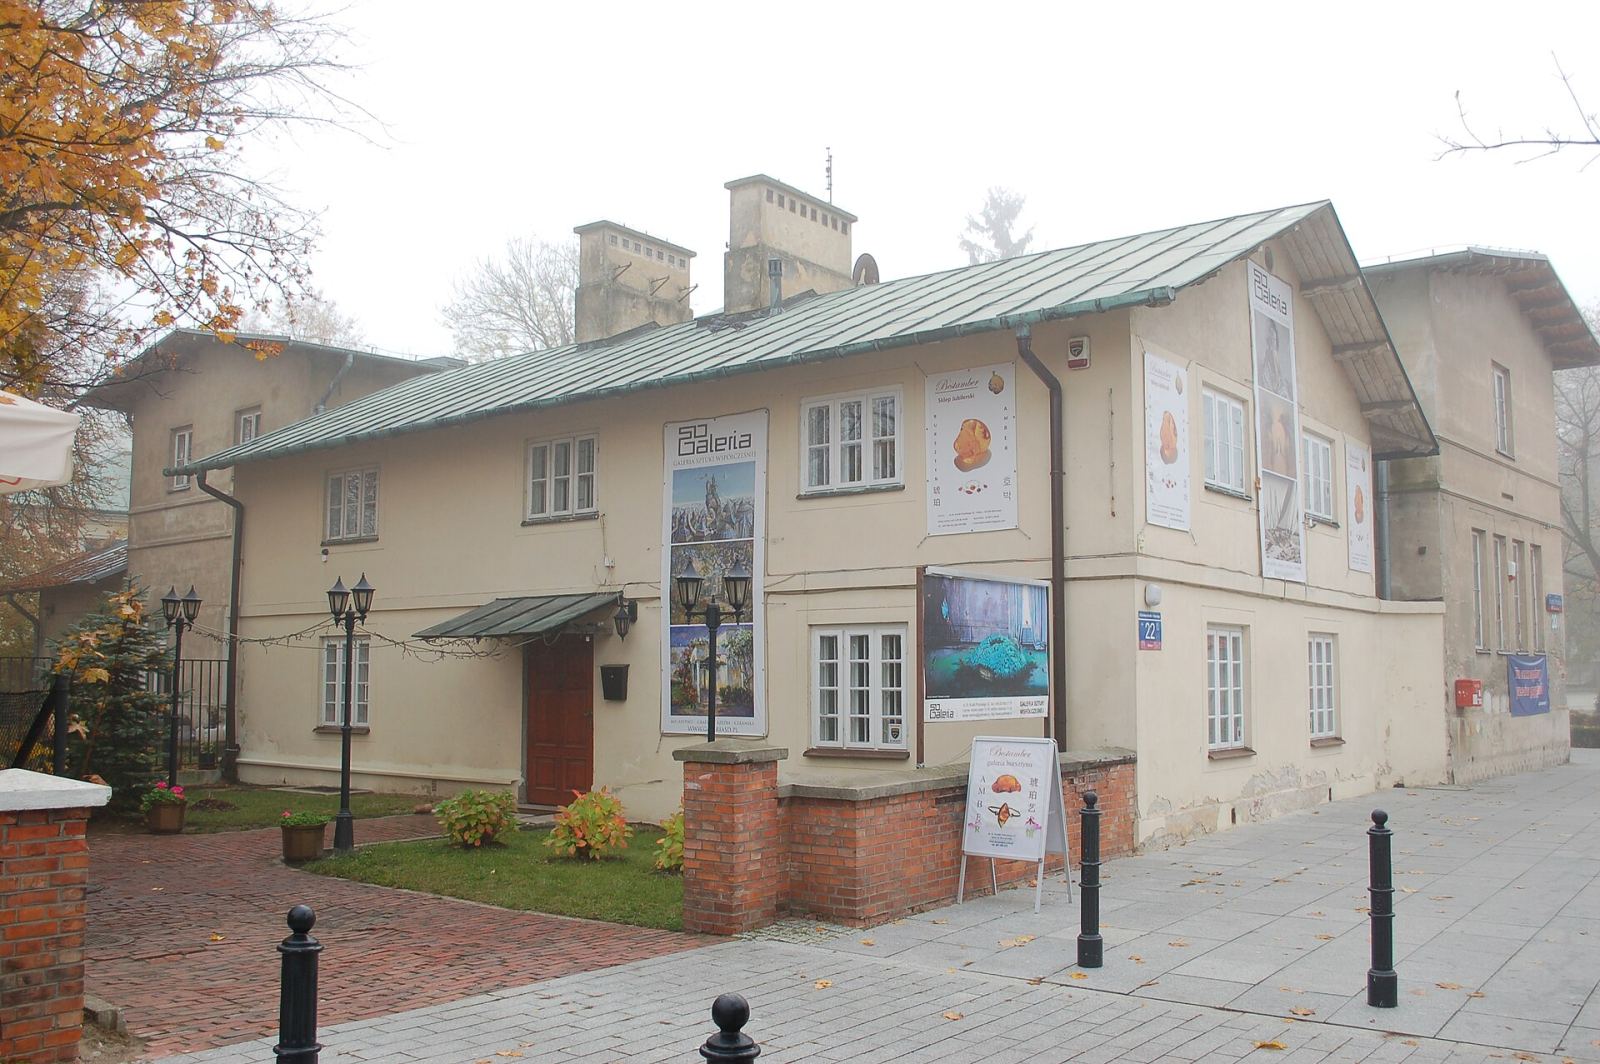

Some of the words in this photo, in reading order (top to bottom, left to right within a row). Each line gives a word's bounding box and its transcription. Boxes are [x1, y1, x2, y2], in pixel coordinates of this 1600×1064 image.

[1254, 278, 1287, 316] Galeria
[678, 430, 752, 457] Galeria
[1145, 622, 1156, 640] 22
[929, 709, 955, 719] Galeria
[987, 760, 1005, 768] galeria
[974, 775, 987, 833] AMBER
